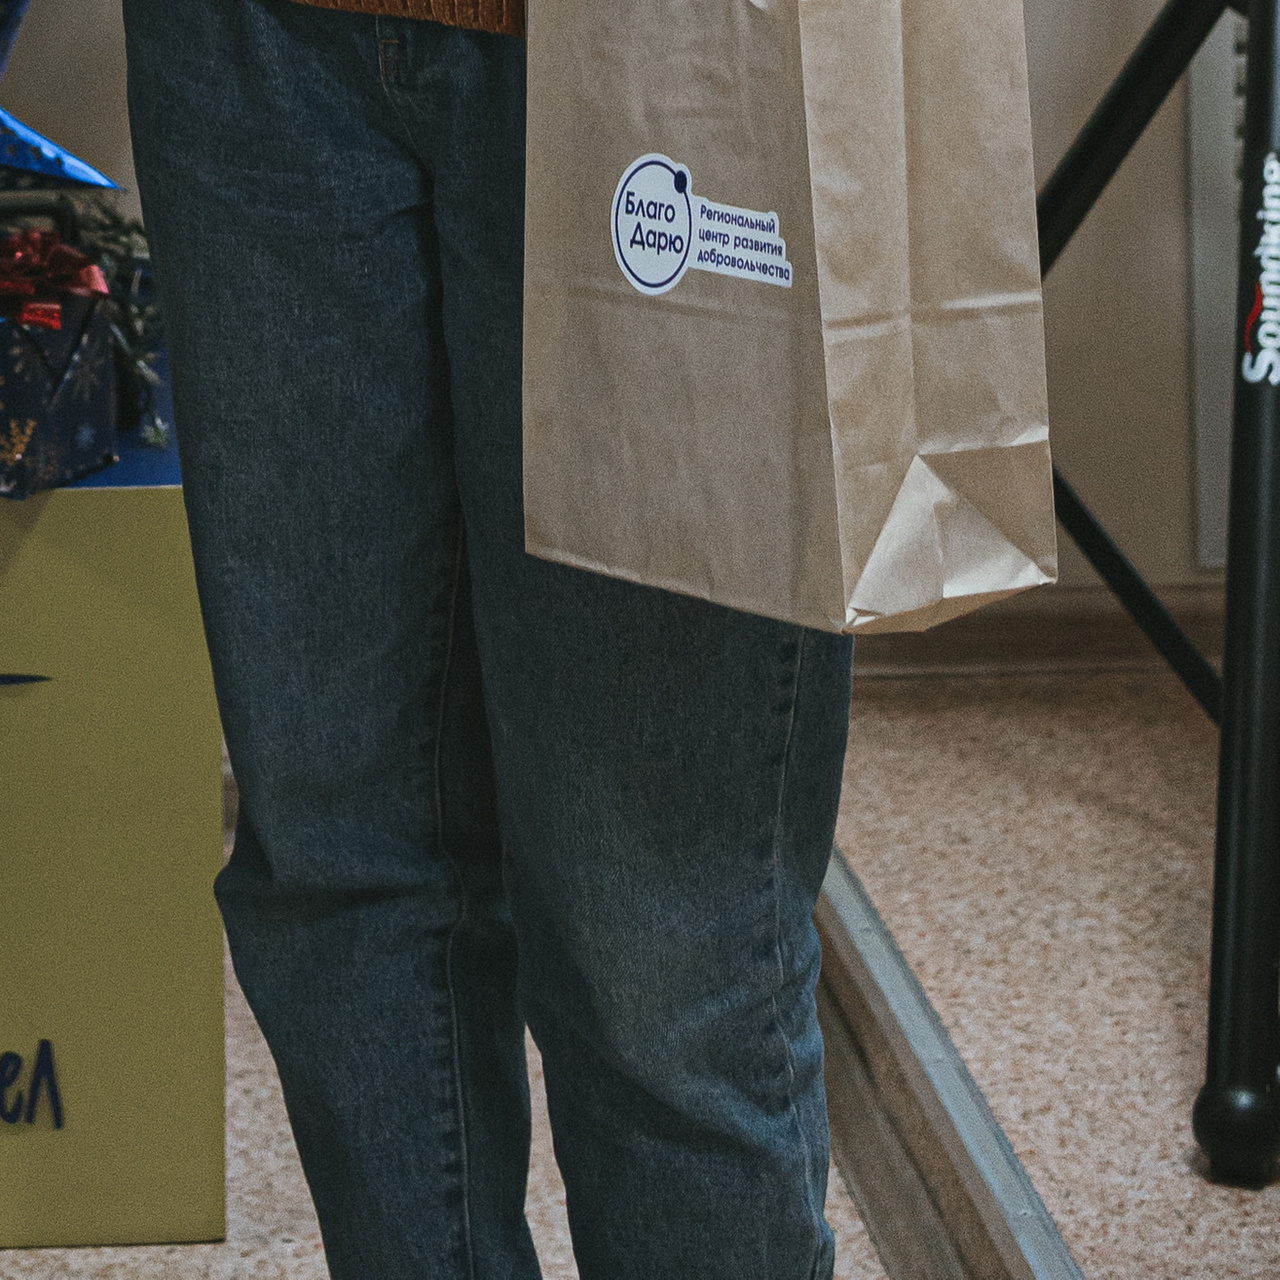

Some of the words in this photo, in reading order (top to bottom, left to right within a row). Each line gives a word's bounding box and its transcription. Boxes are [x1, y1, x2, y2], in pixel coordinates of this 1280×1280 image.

[624, 190, 676, 224] Благо
[700, 203, 776, 234] Региональный
[629, 221, 684, 256] Дарю
[698, 228, 730, 246] центр
[733, 235, 783, 257] развития
[697, 248, 790, 281] добровольчества
